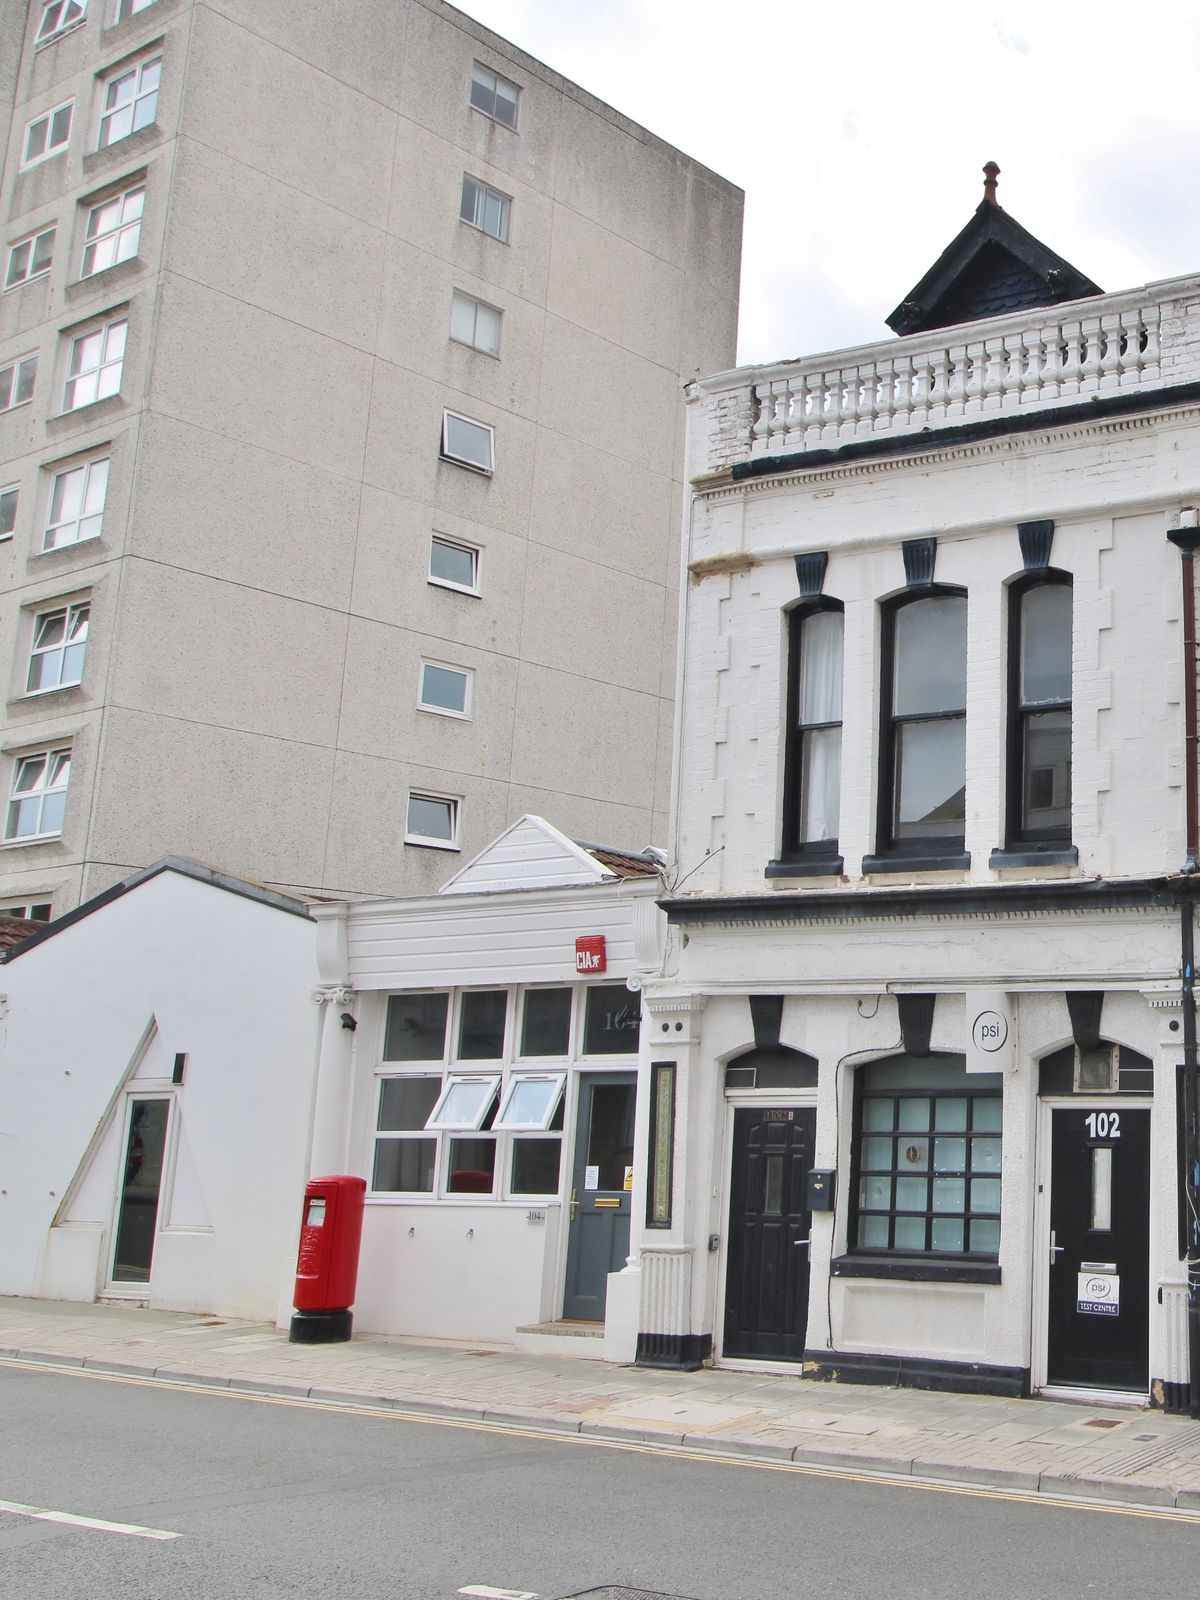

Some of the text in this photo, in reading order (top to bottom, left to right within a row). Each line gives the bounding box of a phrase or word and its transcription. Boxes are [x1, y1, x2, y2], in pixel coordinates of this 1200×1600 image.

[576, 951, 592, 969] CIA
[982, 1021, 1000, 1041] psi
[1085, 1112, 1121, 1137] 102
[1091, 1284, 1107, 1294] psi
[1080, 1302, 1116, 1313] TEST CENTRE
